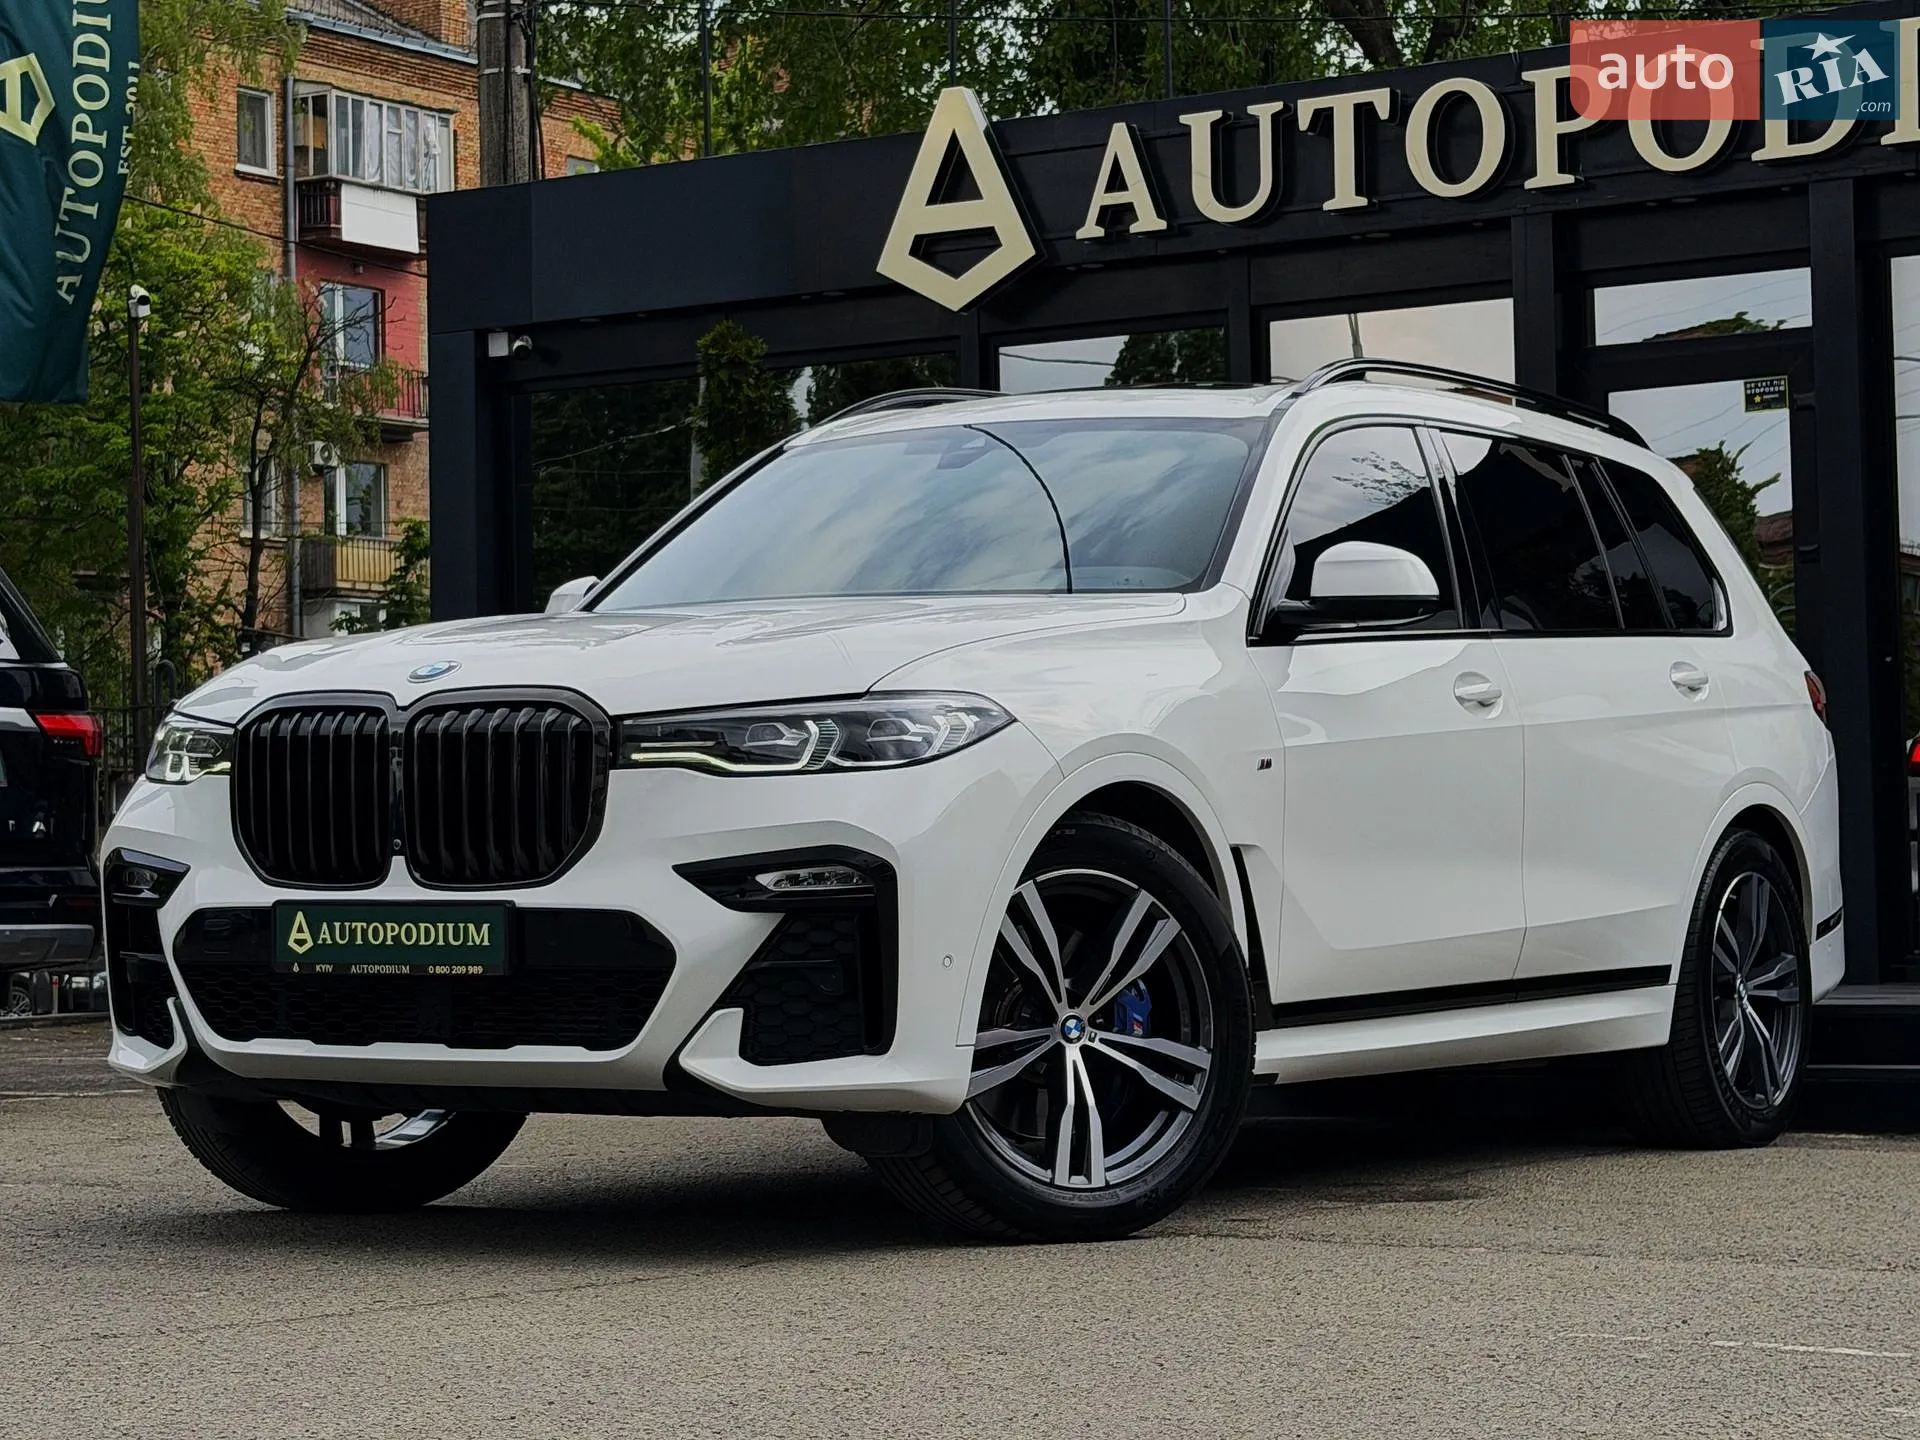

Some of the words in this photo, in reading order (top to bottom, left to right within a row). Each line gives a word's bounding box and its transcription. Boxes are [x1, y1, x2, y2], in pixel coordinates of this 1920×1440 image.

[55, 0, 112, 304] AUTOPODI
[317, 921, 491, 946] AUTOPODIUM
[315, 964, 334, 973] KYIV
[350, 964, 411, 974] AUTOPODIUM
[428, 965, 435, 974] 0
[435, 965, 451, 974] 800
[451, 965, 467, 974] 209
[467, 965, 484, 974] 989
